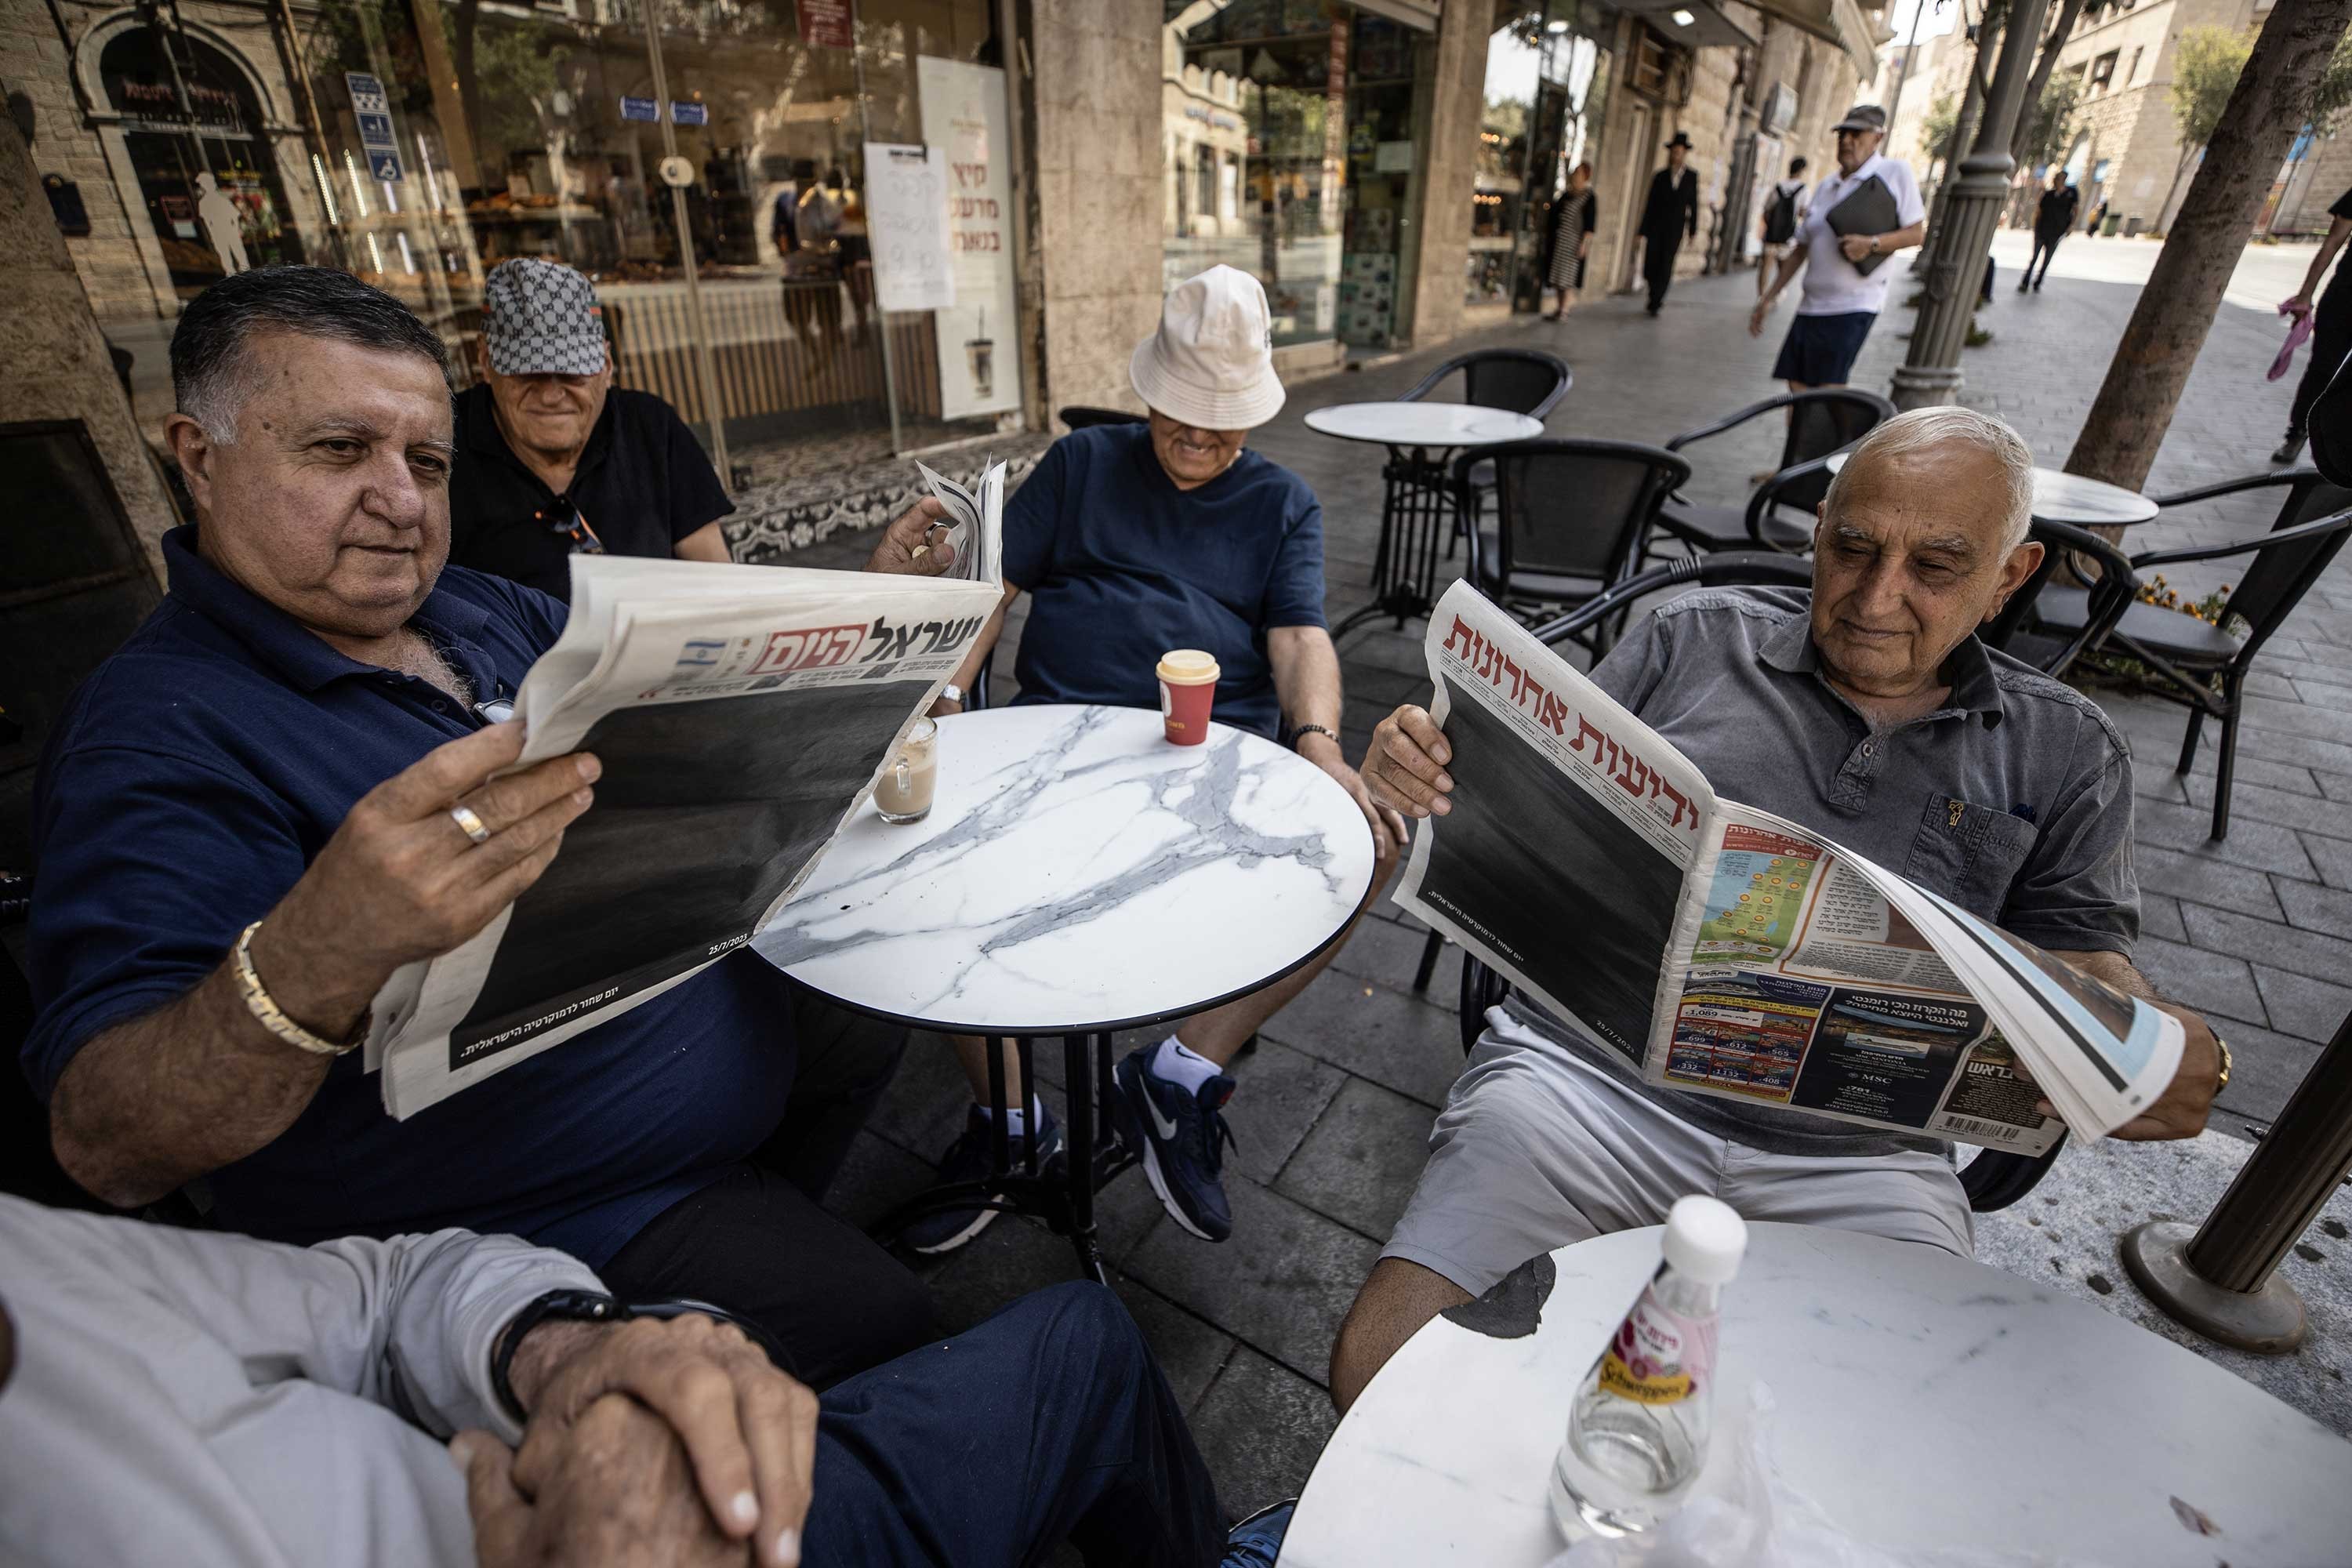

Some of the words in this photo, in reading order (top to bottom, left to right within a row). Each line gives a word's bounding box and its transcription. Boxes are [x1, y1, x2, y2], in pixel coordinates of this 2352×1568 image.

[953, 162, 987, 188] קיץ
[950, 198, 1000, 218] מרענ
[860, 615, 984, 663] ישראל
[757, 629, 862, 673] היום
[1442, 613, 1569, 735] אחרונות
[1568, 712, 1700, 831] ידיעות
[1727, 826, 1777, 840] אחרונות
[1428, 891, 1462, 916] הישראלית.
[1461, 912, 1497, 942] לדמוקרטיה
[708, 933, 747, 956] 25/7/2023
[1496, 938, 1513, 954] שחור
[1513, 951, 1524, 962] יום
[579, 993, 604, 1010] שחור
[604, 986, 619, 1000] יום
[1852, 995, 1889, 1007] רומנטי
[1845, 1000, 1889, 1014] מחיפה?
[1891, 1000, 1911, 1010] הכי
[1912, 1004, 1947, 1016] הקרוז
[1949, 1008, 1968, 1018] מה
[524, 1002, 578, 1033] לדמוקרטיה
[1890, 1009, 1923, 1020] היוצא
[1926, 1014, 1969, 1028] ואלגנטי
[460, 1026, 523, 1058] הישראלית.
[1862, 1073, 1893, 1084] MSC
[1966, 1062, 2014, 1080] בראש
